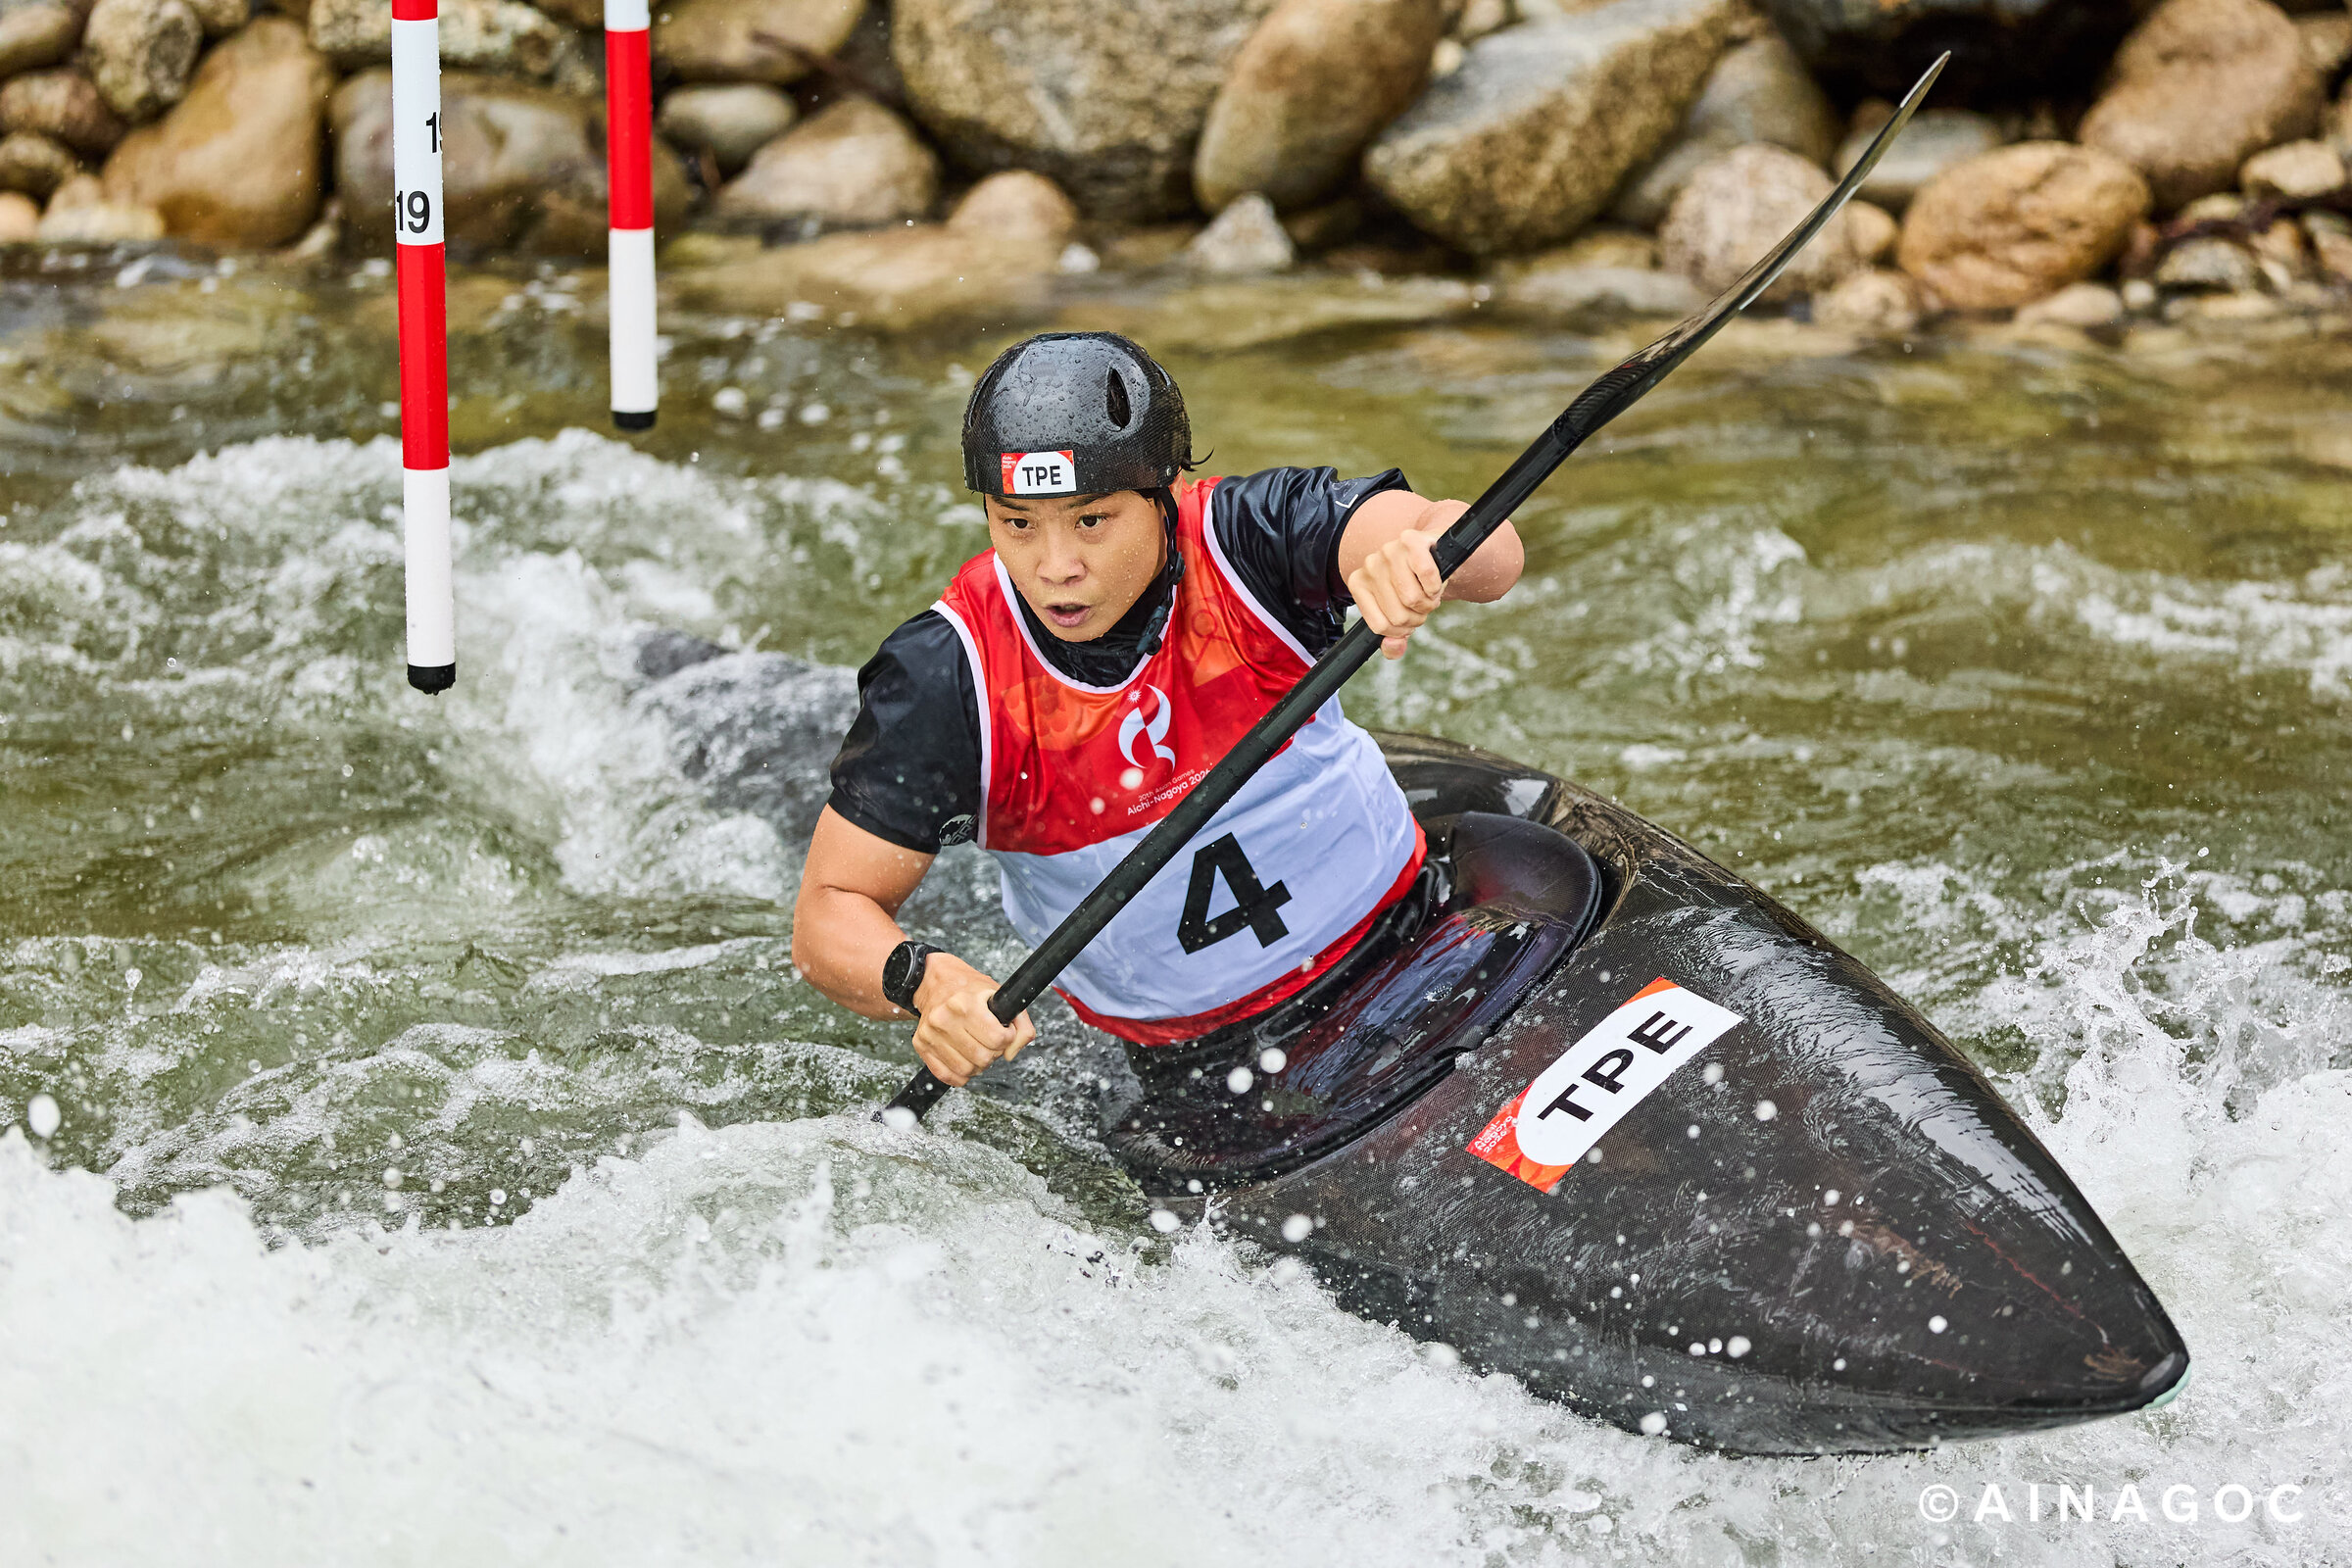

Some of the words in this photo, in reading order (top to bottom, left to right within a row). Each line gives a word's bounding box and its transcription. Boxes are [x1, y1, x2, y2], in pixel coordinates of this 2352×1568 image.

[425, 111, 443, 154] 1
[396, 190, 430, 234] 19
[1022, 466, 1062, 487] TPE
[1127, 781, 1189, 815] Aichi-Nagoya
[1138, 790, 1154, 802] 20th
[1172, 768, 1196, 784] Games
[1177, 831, 1293, 956] 4
[1537, 1010, 1693, 1123] TPE
[1477, 1115, 1513, 1151] Nagoya
[1483, 1130, 1507, 1153] 2026
